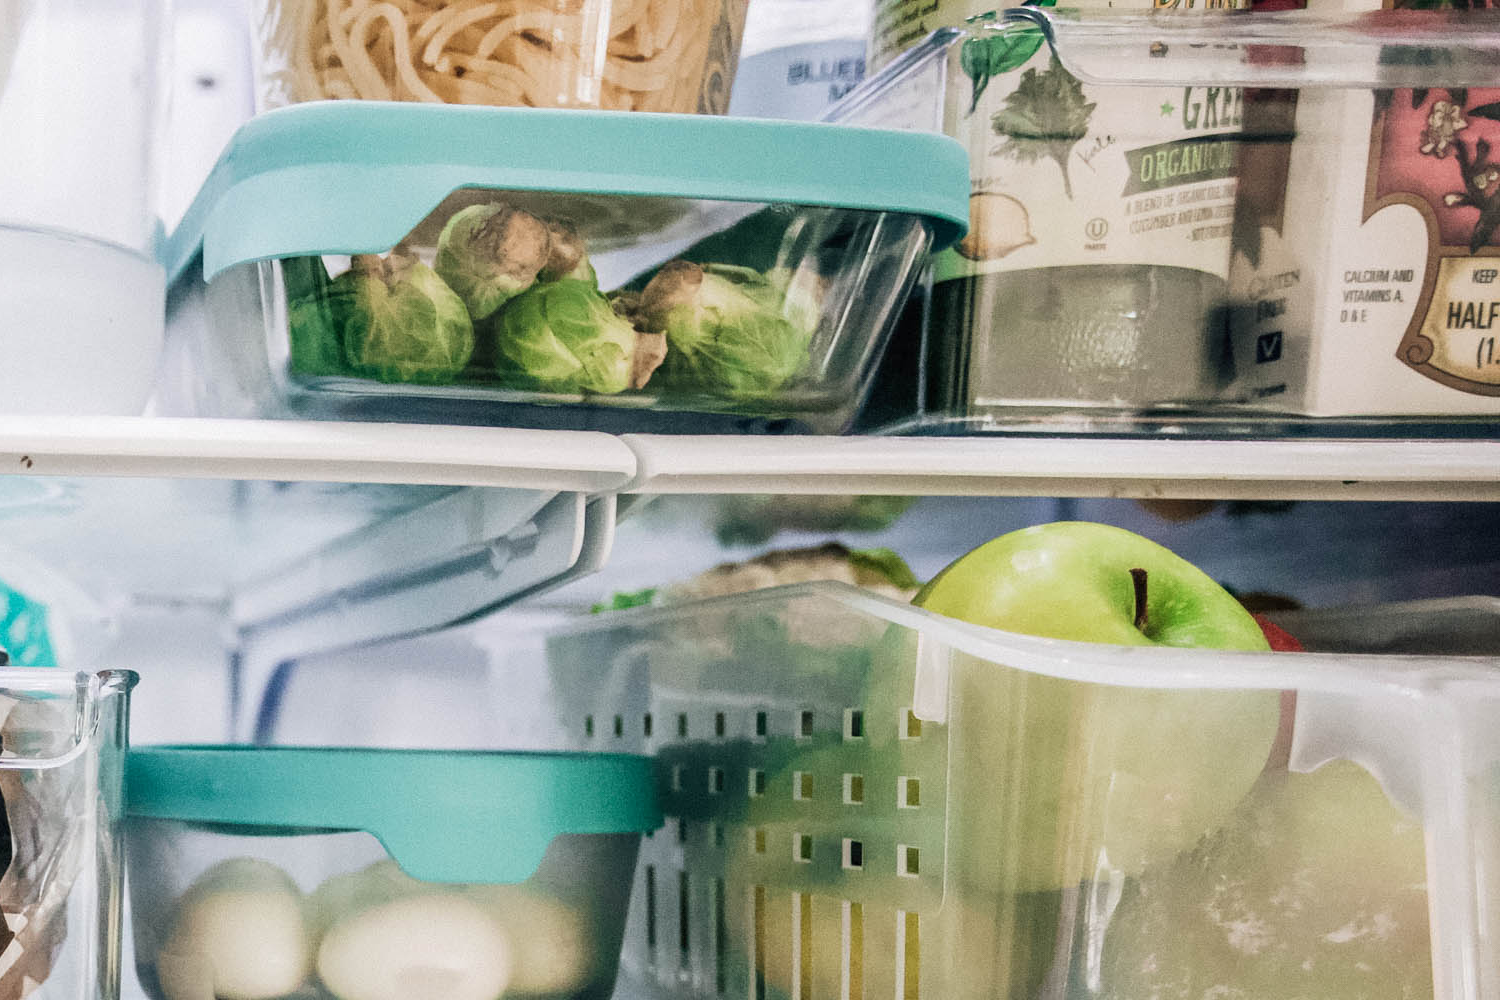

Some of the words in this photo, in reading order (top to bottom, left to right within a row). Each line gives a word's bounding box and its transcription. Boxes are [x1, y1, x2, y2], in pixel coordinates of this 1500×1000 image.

[1343, 270, 1390, 284] CALCIUM
[1391, 269, 1414, 283] AND
[1472, 268, 1499, 284] KEEP
[1343, 289, 1391, 303] VITAMINS
[1446, 300, 1500, 330] HALF
